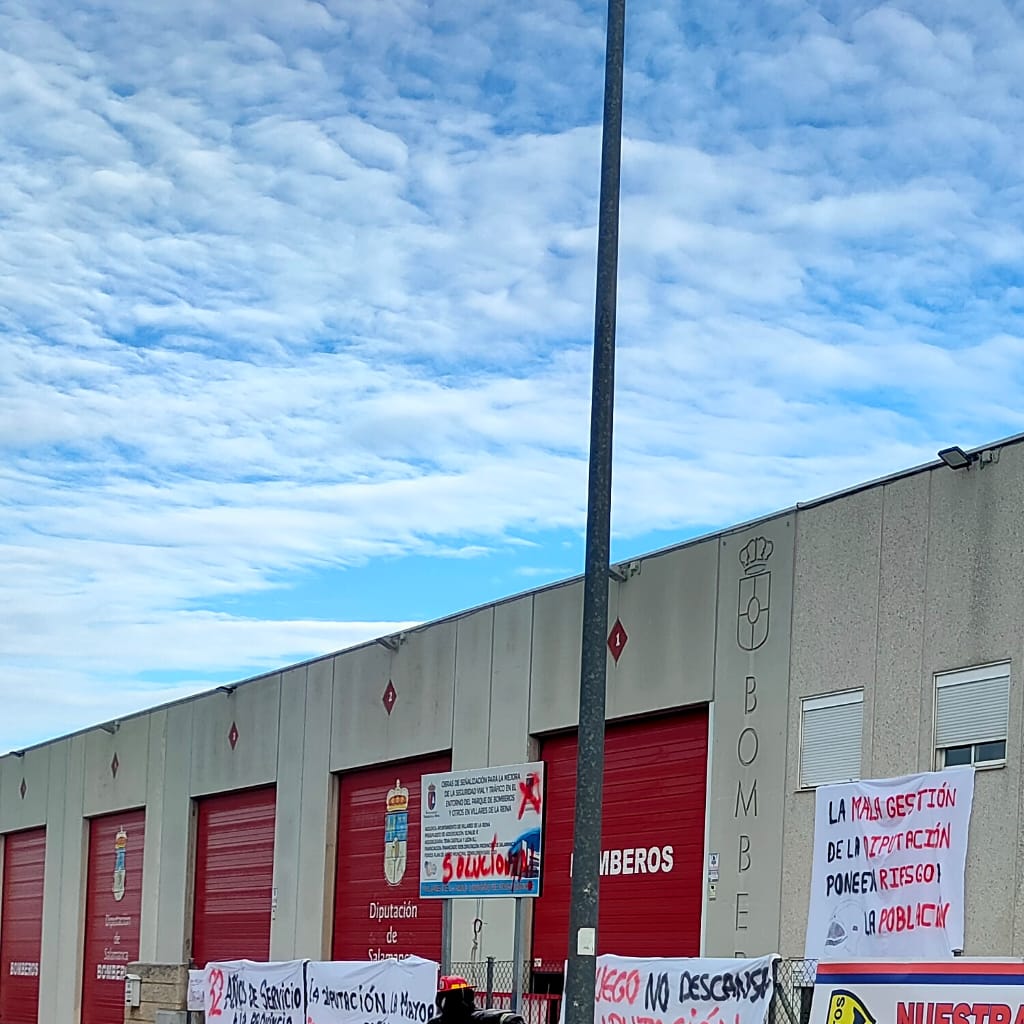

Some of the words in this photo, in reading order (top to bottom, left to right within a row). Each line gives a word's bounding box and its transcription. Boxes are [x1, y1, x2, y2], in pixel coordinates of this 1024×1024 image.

[615, 633, 621, 647] 1
[735, 676, 758, 958] BOMBE
[829, 798, 846, 824] LA
[852, 796, 882, 822] MALA
[886, 782, 957, 818] GESTIÓN
[828, 840, 844, 863] DE
[847, 836, 860, 858] LA
[863, 822, 951, 860] DIPUTACIÓN
[570, 846, 674, 877] MBEROS
[826, 872, 860, 896] PONE
[879, 864, 935, 890] RIESGO
[369, 901, 418, 922] Diputación
[864, 910, 876, 936] LA
[387, 926, 398, 943] de
[97, 964, 127, 980] BOMBER
[249, 983, 260, 1008] DE
[260, 979, 301, 1010] SERVICIO
[309, 978, 319, 1003] LA
[595, 965, 640, 1004] UEGO
[645, 972, 670, 1013] NO
